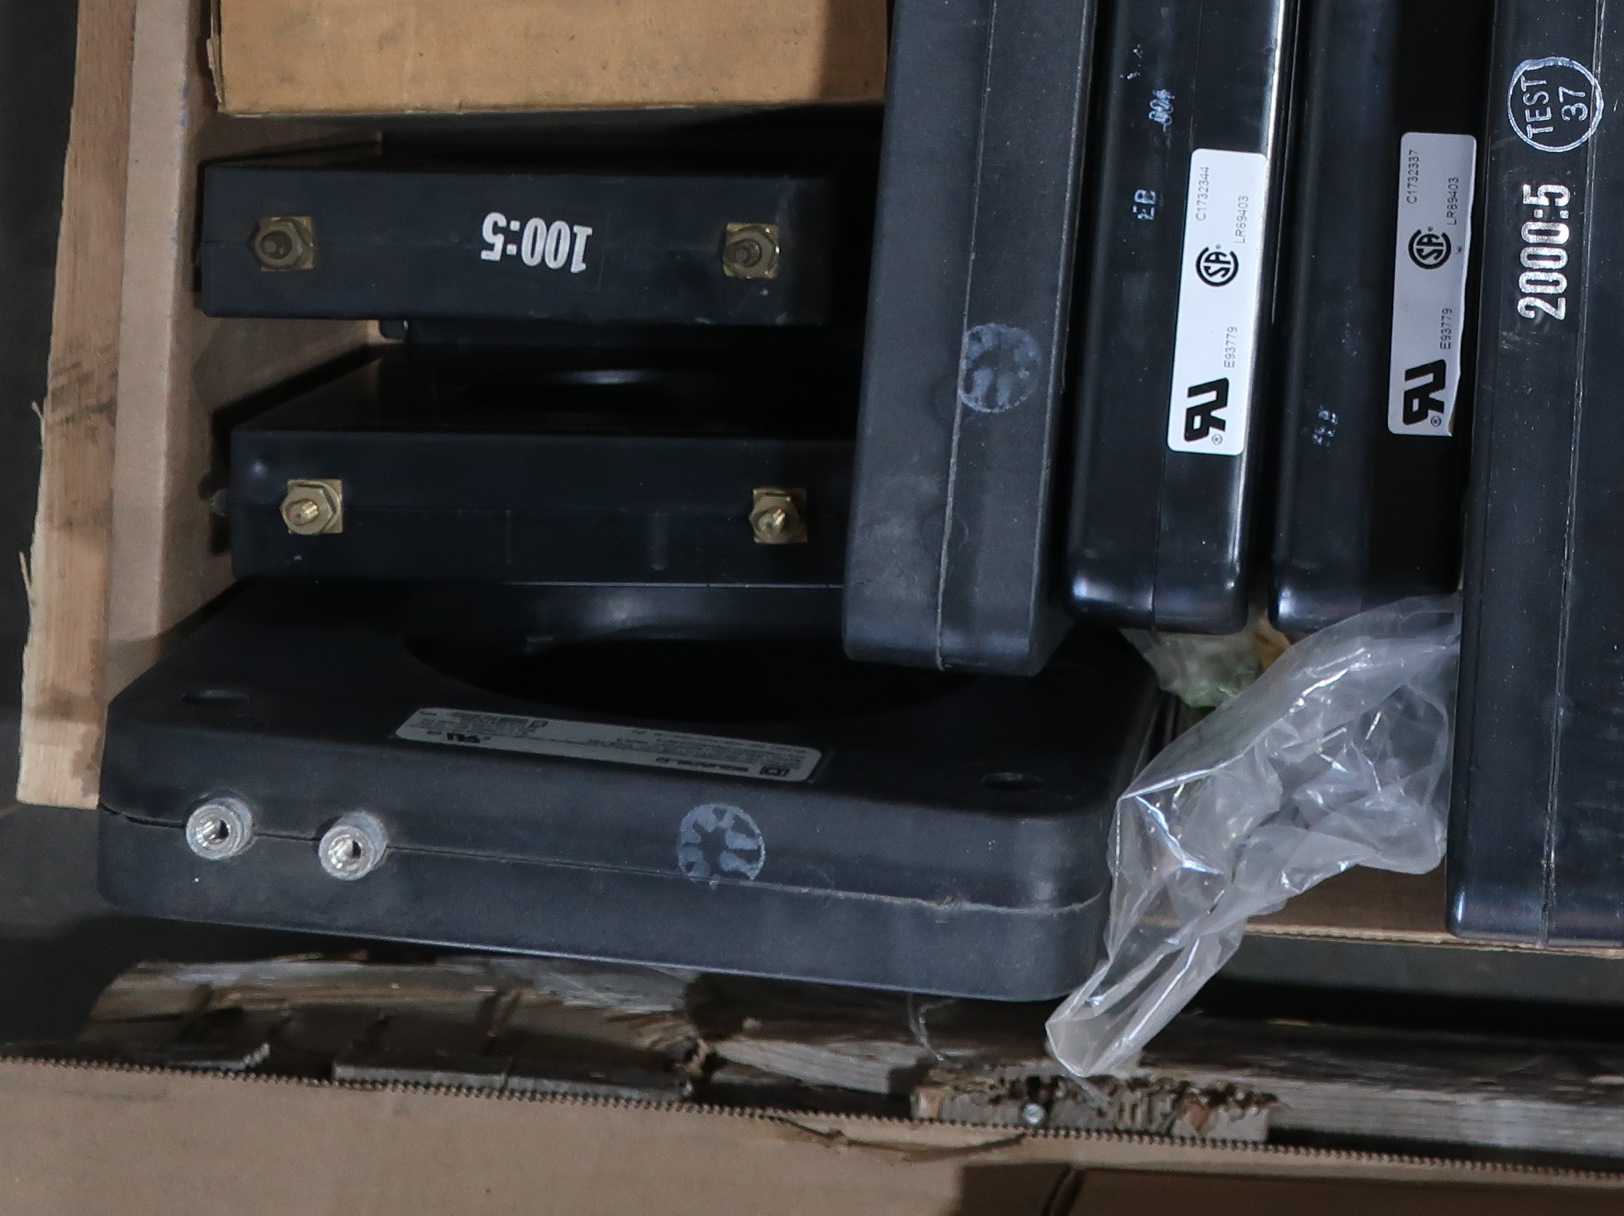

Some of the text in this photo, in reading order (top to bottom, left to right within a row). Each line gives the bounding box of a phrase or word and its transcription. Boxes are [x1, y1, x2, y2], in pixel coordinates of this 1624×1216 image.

[1520, 75, 1554, 139] TEST
[1558, 86, 1588, 121] 37
[1195, 166, 1210, 221] C1732344
[480, 211, 593, 274] 100:5
[1516, 184, 1570, 321] 2000:5
[1223, 326, 1238, 368] E93779
[1439, 308, 1453, 350] E93779
